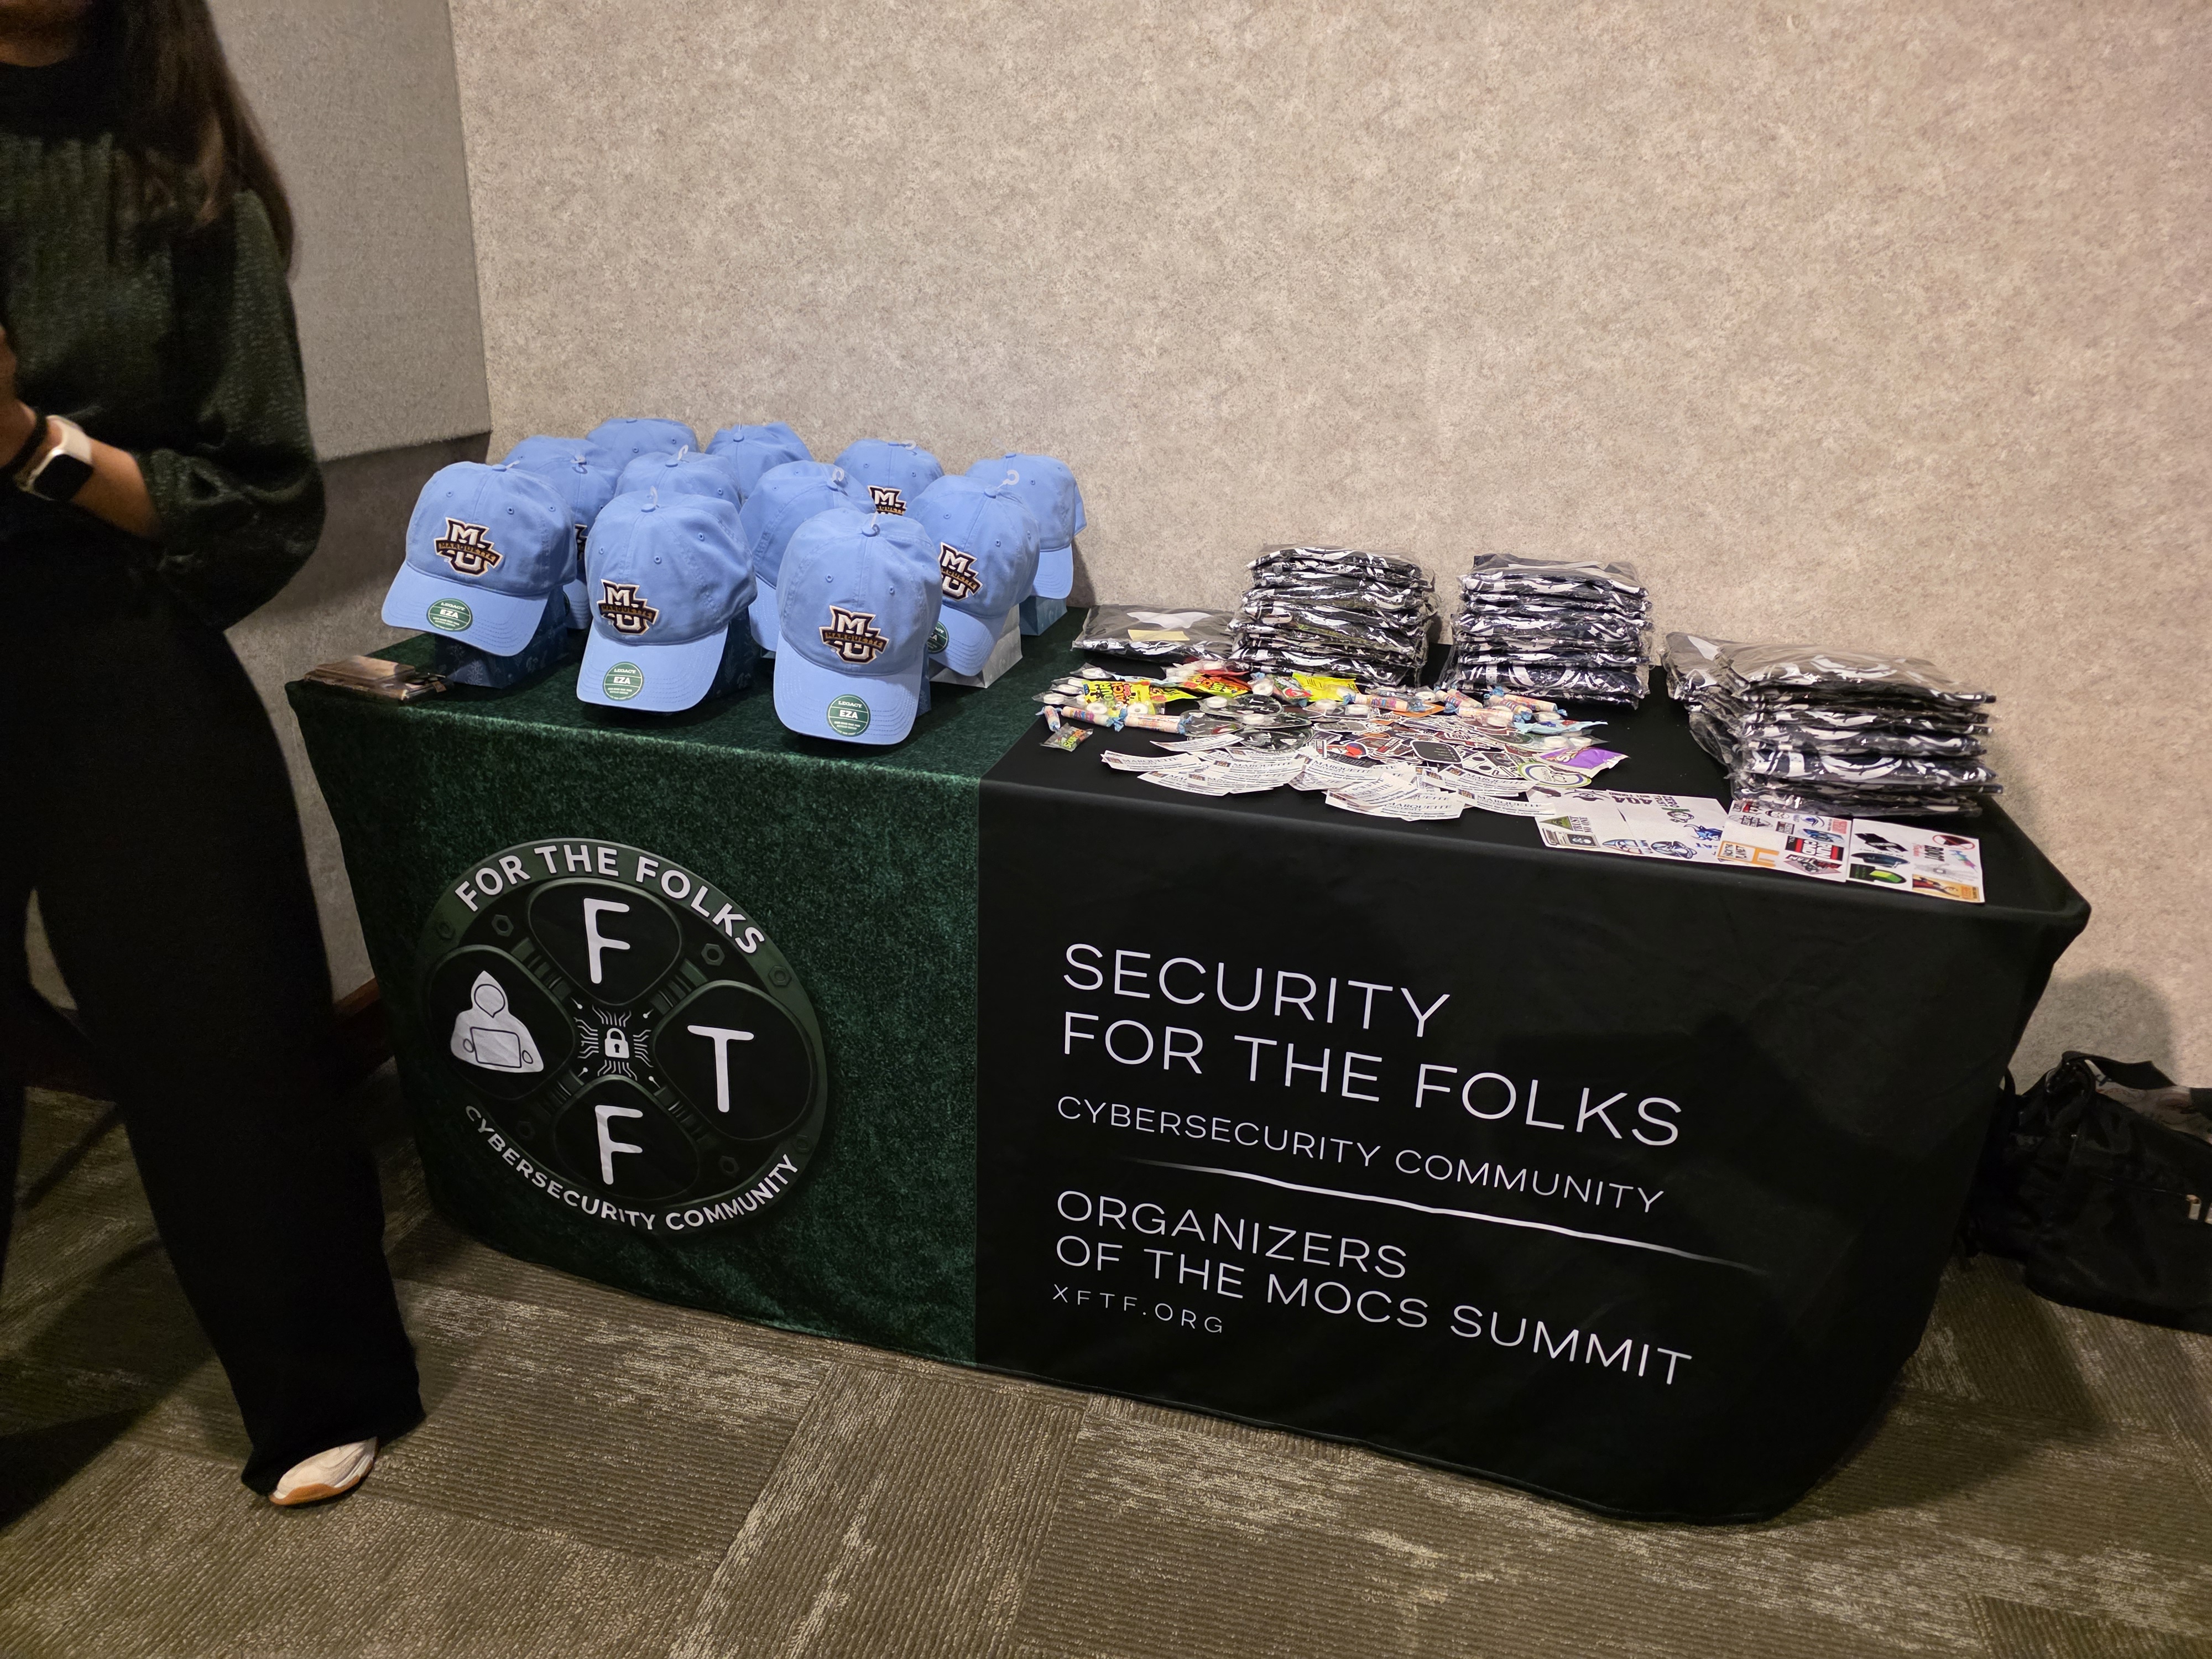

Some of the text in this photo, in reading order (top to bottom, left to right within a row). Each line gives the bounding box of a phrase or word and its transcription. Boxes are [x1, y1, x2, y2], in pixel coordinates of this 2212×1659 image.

[439, 541, 495, 562] MARQUETTE
[440, 609, 459, 619] EZA
[441, 602, 466, 612] LEGACY
[601, 604, 653, 618] MARQUETTE
[826, 632, 882, 646] MARQUETTE
[613, 676, 630, 685] EZA
[839, 709, 858, 719] EZA
[1314, 760, 1373, 773] MARQUETTE
[1477, 795, 1542, 808] MARQUETTE
[1611, 796, 1652, 805] 404
[1569, 815, 1584, 832] TRUST
[1579, 816, 1589, 826] ONE
[1802, 839, 1817, 855] CMD
[1815, 842, 1833, 858] RUN
[1924, 845, 1945, 862] ROOT
[455, 844, 765, 954] FOR THE FOLKS
[583, 898, 630, 984] F
[1063, 943, 1450, 1037] SECURITY
[687, 1025, 754, 1113] T
[1065, 1011, 1682, 1146] FOR THE FOLKS
[594, 1105, 643, 1185] F
[1057, 1096, 1664, 1213] CYBERSECURITY COMMUNITY
[465, 1105, 798, 1231] CYBERSECURITY COMMUNITY
[1057, 1191, 1406, 1279] ORGANIZERS
[1053, 1284, 1223, 1333] XFTF.ORG
[1056, 1235, 1692, 1385] OF THE MOCS SUMMIT
